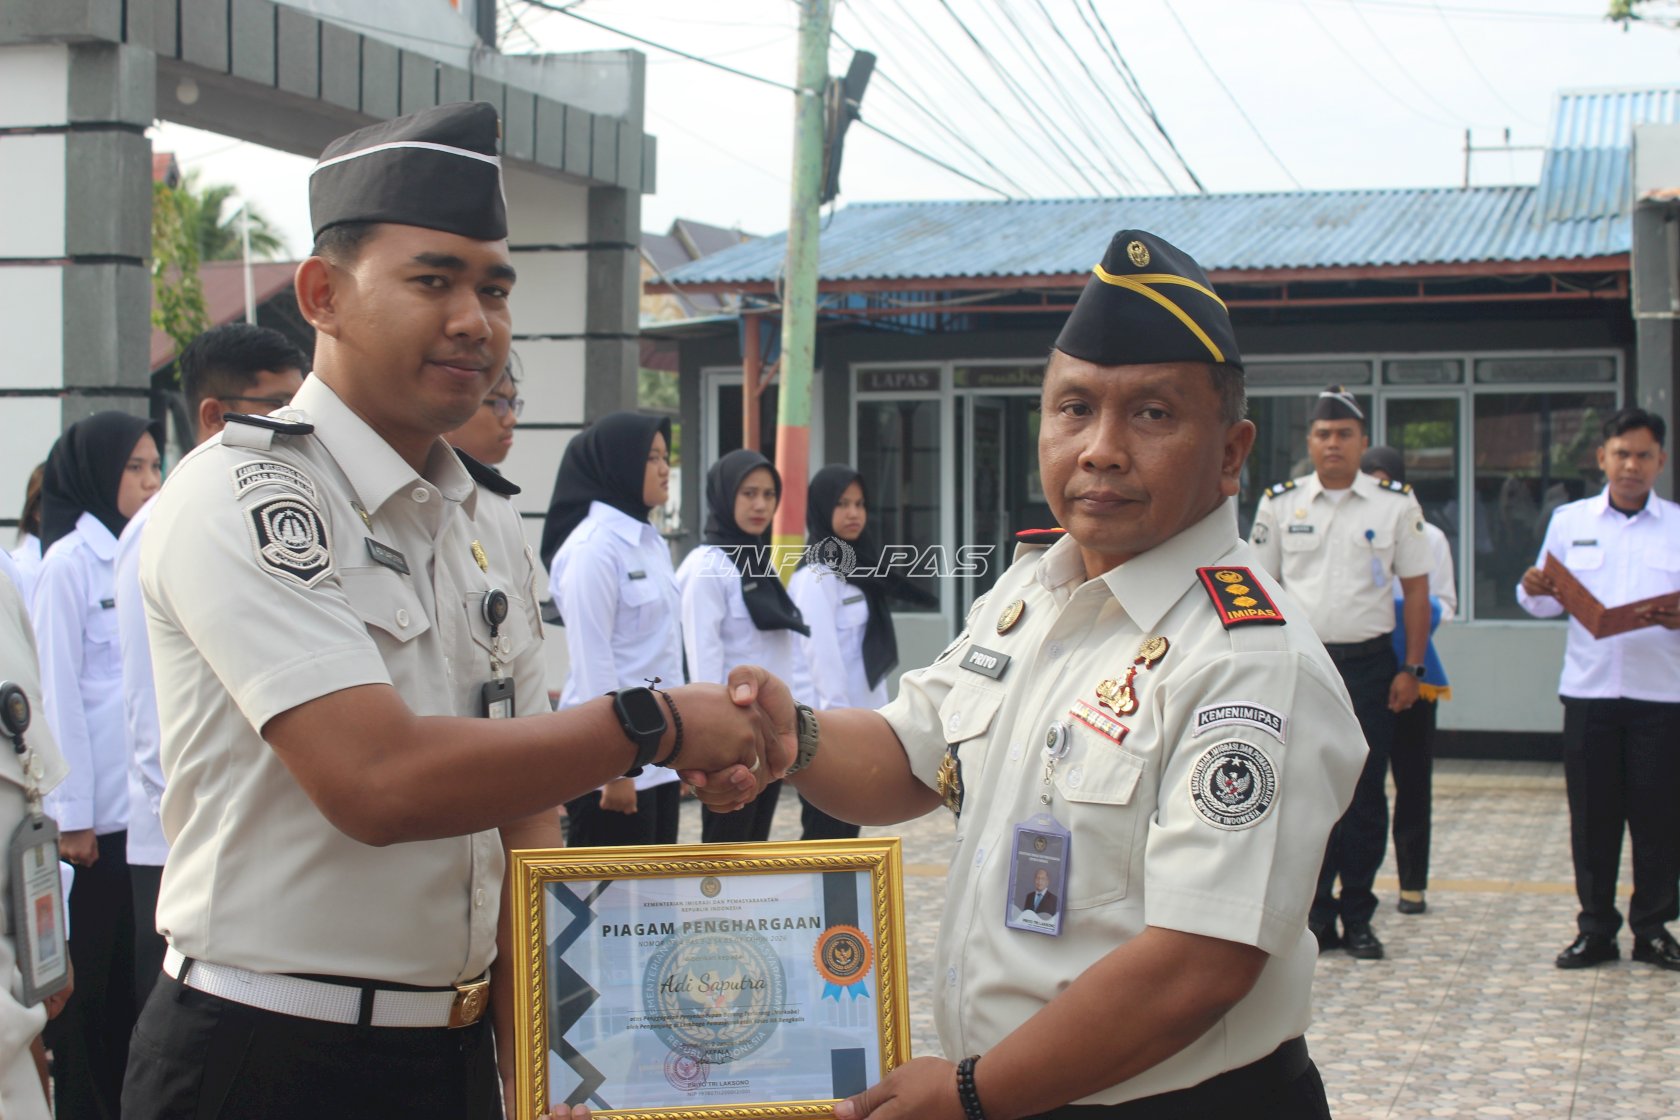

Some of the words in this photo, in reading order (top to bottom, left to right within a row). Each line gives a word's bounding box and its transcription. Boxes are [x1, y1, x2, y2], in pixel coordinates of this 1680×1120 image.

[871, 372, 929, 387] LAPAS
[240, 473, 268, 489] LAPAS
[1227, 609, 1276, 619] IMIPAS
[1200, 707, 1280, 729] KEMENIMIPAS
[1191, 751, 1211, 794] KEMENTERIAN
[1210, 742, 1240, 757] IMIGRASI
[1240, 744, 1254, 756] DAN
[1252, 749, 1275, 806] PEMASYARAKATAN
[1195, 799, 1224, 824] REPUBLIK
[1224, 809, 1262, 825] INDONESIA
[602, 922, 675, 937] PIAGAM
[682, 916, 821, 935] PENGHARGAAN
[638, 940, 665, 948] NOMOR
[660, 974, 693, 994] Adi
[698, 972, 767, 995] Saputra
[719, 1079, 749, 1087] LAKSONO
